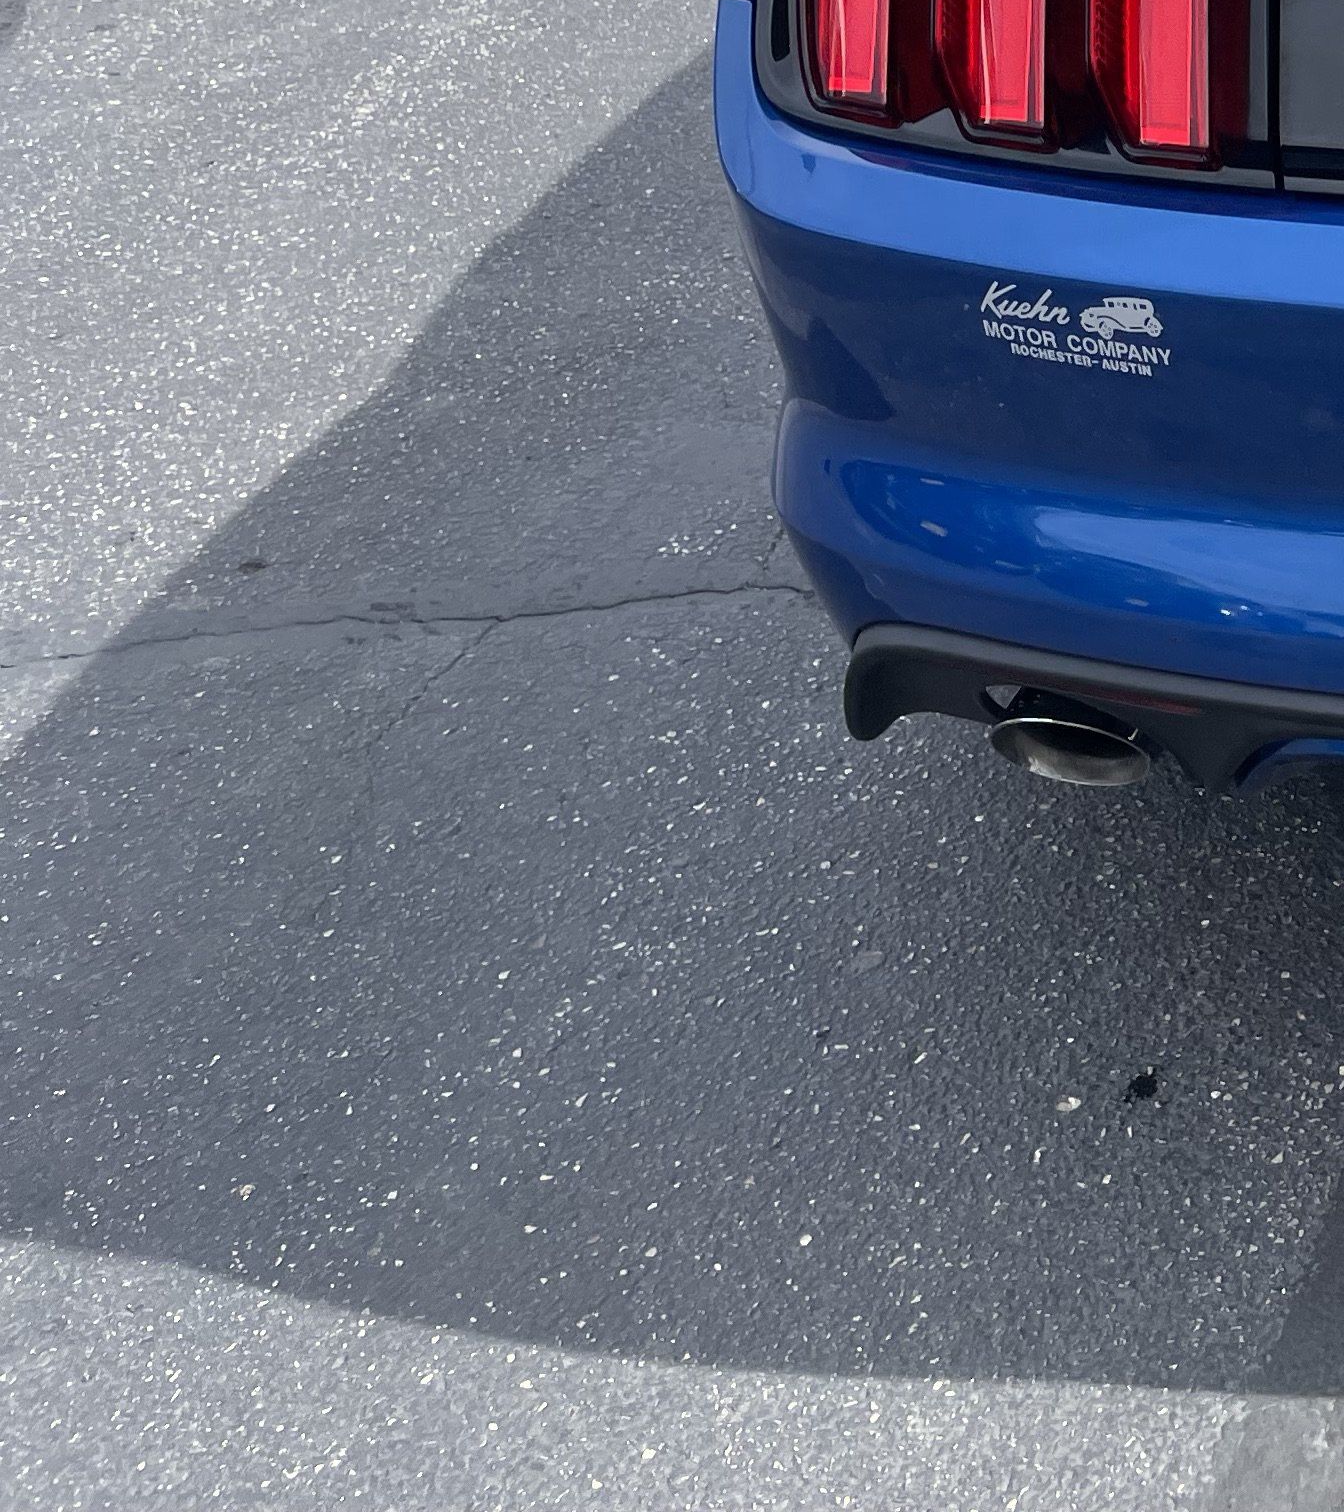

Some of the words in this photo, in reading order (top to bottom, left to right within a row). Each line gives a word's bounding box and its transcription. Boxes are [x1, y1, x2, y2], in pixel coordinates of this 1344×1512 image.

[981, 281, 1070, 325] Kuehn
[982, 319, 1058, 349] MOTOR
[1066, 334, 1172, 366] COMPANY
